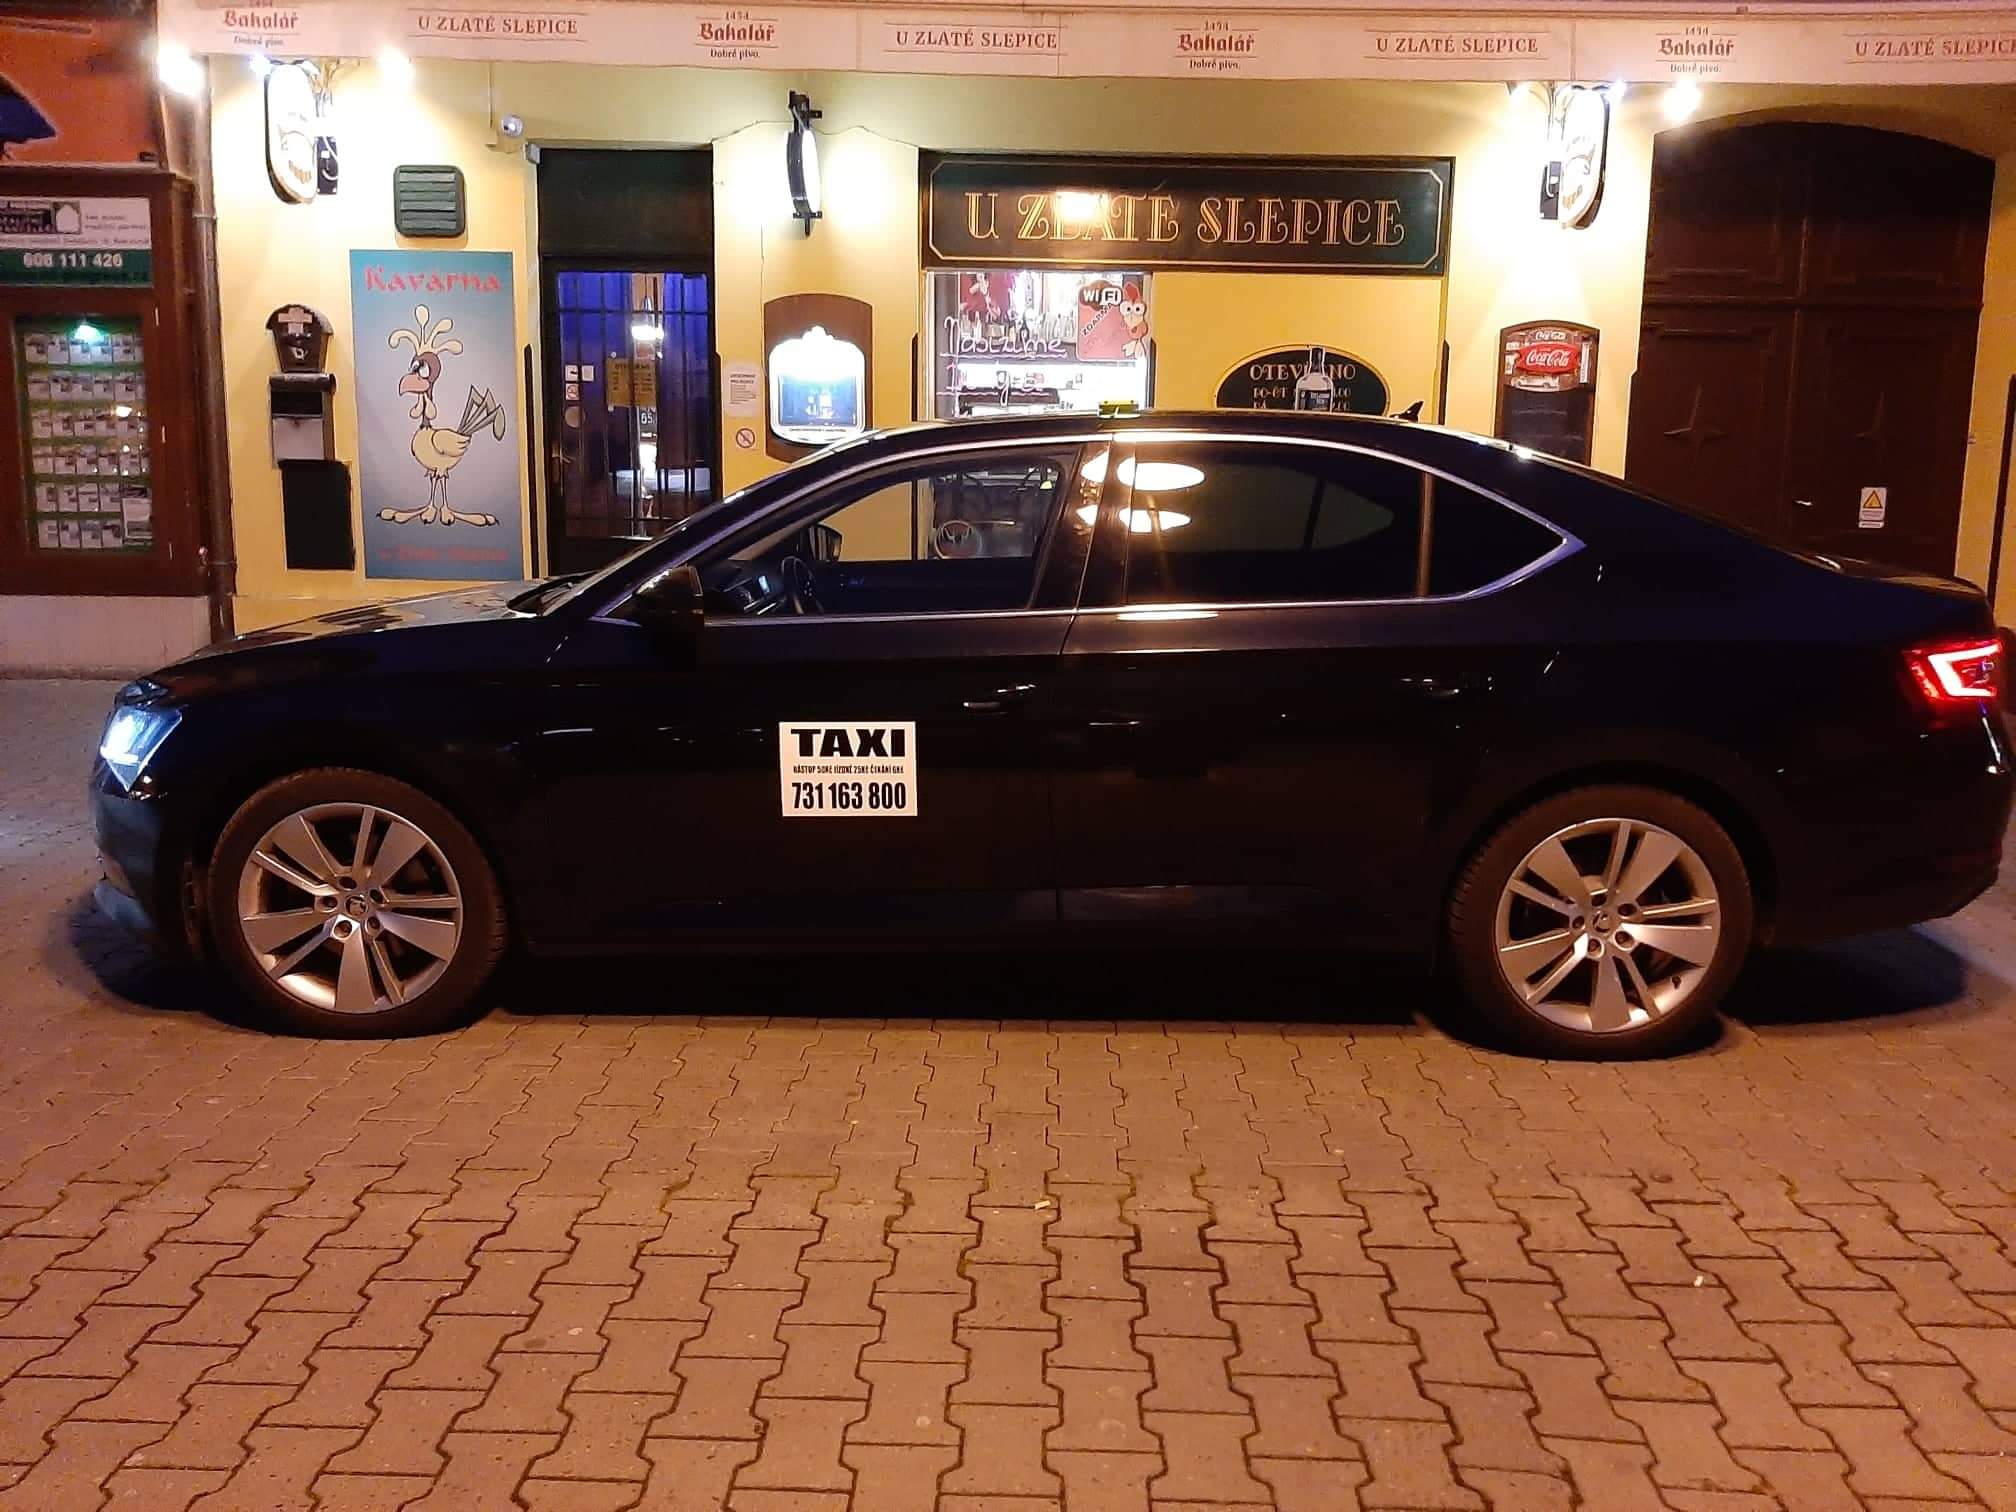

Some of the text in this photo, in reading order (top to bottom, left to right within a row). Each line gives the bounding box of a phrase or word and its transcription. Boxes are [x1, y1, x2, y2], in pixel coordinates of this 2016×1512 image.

[418, 16, 578, 34] U ZLATÉ SLEPICE
[697, 22, 775, 42] Bakalář
[896, 28, 1057, 48] U ZLATÉ SLEPICE
[1177, 33, 1255, 52] Bakalář
[1376, 34, 1538, 53] U ZLATÉ SLEPICE
[1659, 38, 1734, 57] Bakalář
[1856, 41, 1868, 56] U
[1874, 37, 1935, 57] ZLATÉ
[710, 48, 737, 58] Dobré
[1190, 58, 1217, 69] Dobré
[1670, 63, 1697, 74] Dobré
[965, 192, 999, 239] U
[1197, 196, 1406, 247] SLEPICE
[60, 252, 86, 267] 111
[1526, 350, 1571, 368] Coca-Cola
[791, 729, 906, 757] TAXI
[792, 782, 906, 810] 731 163 800
